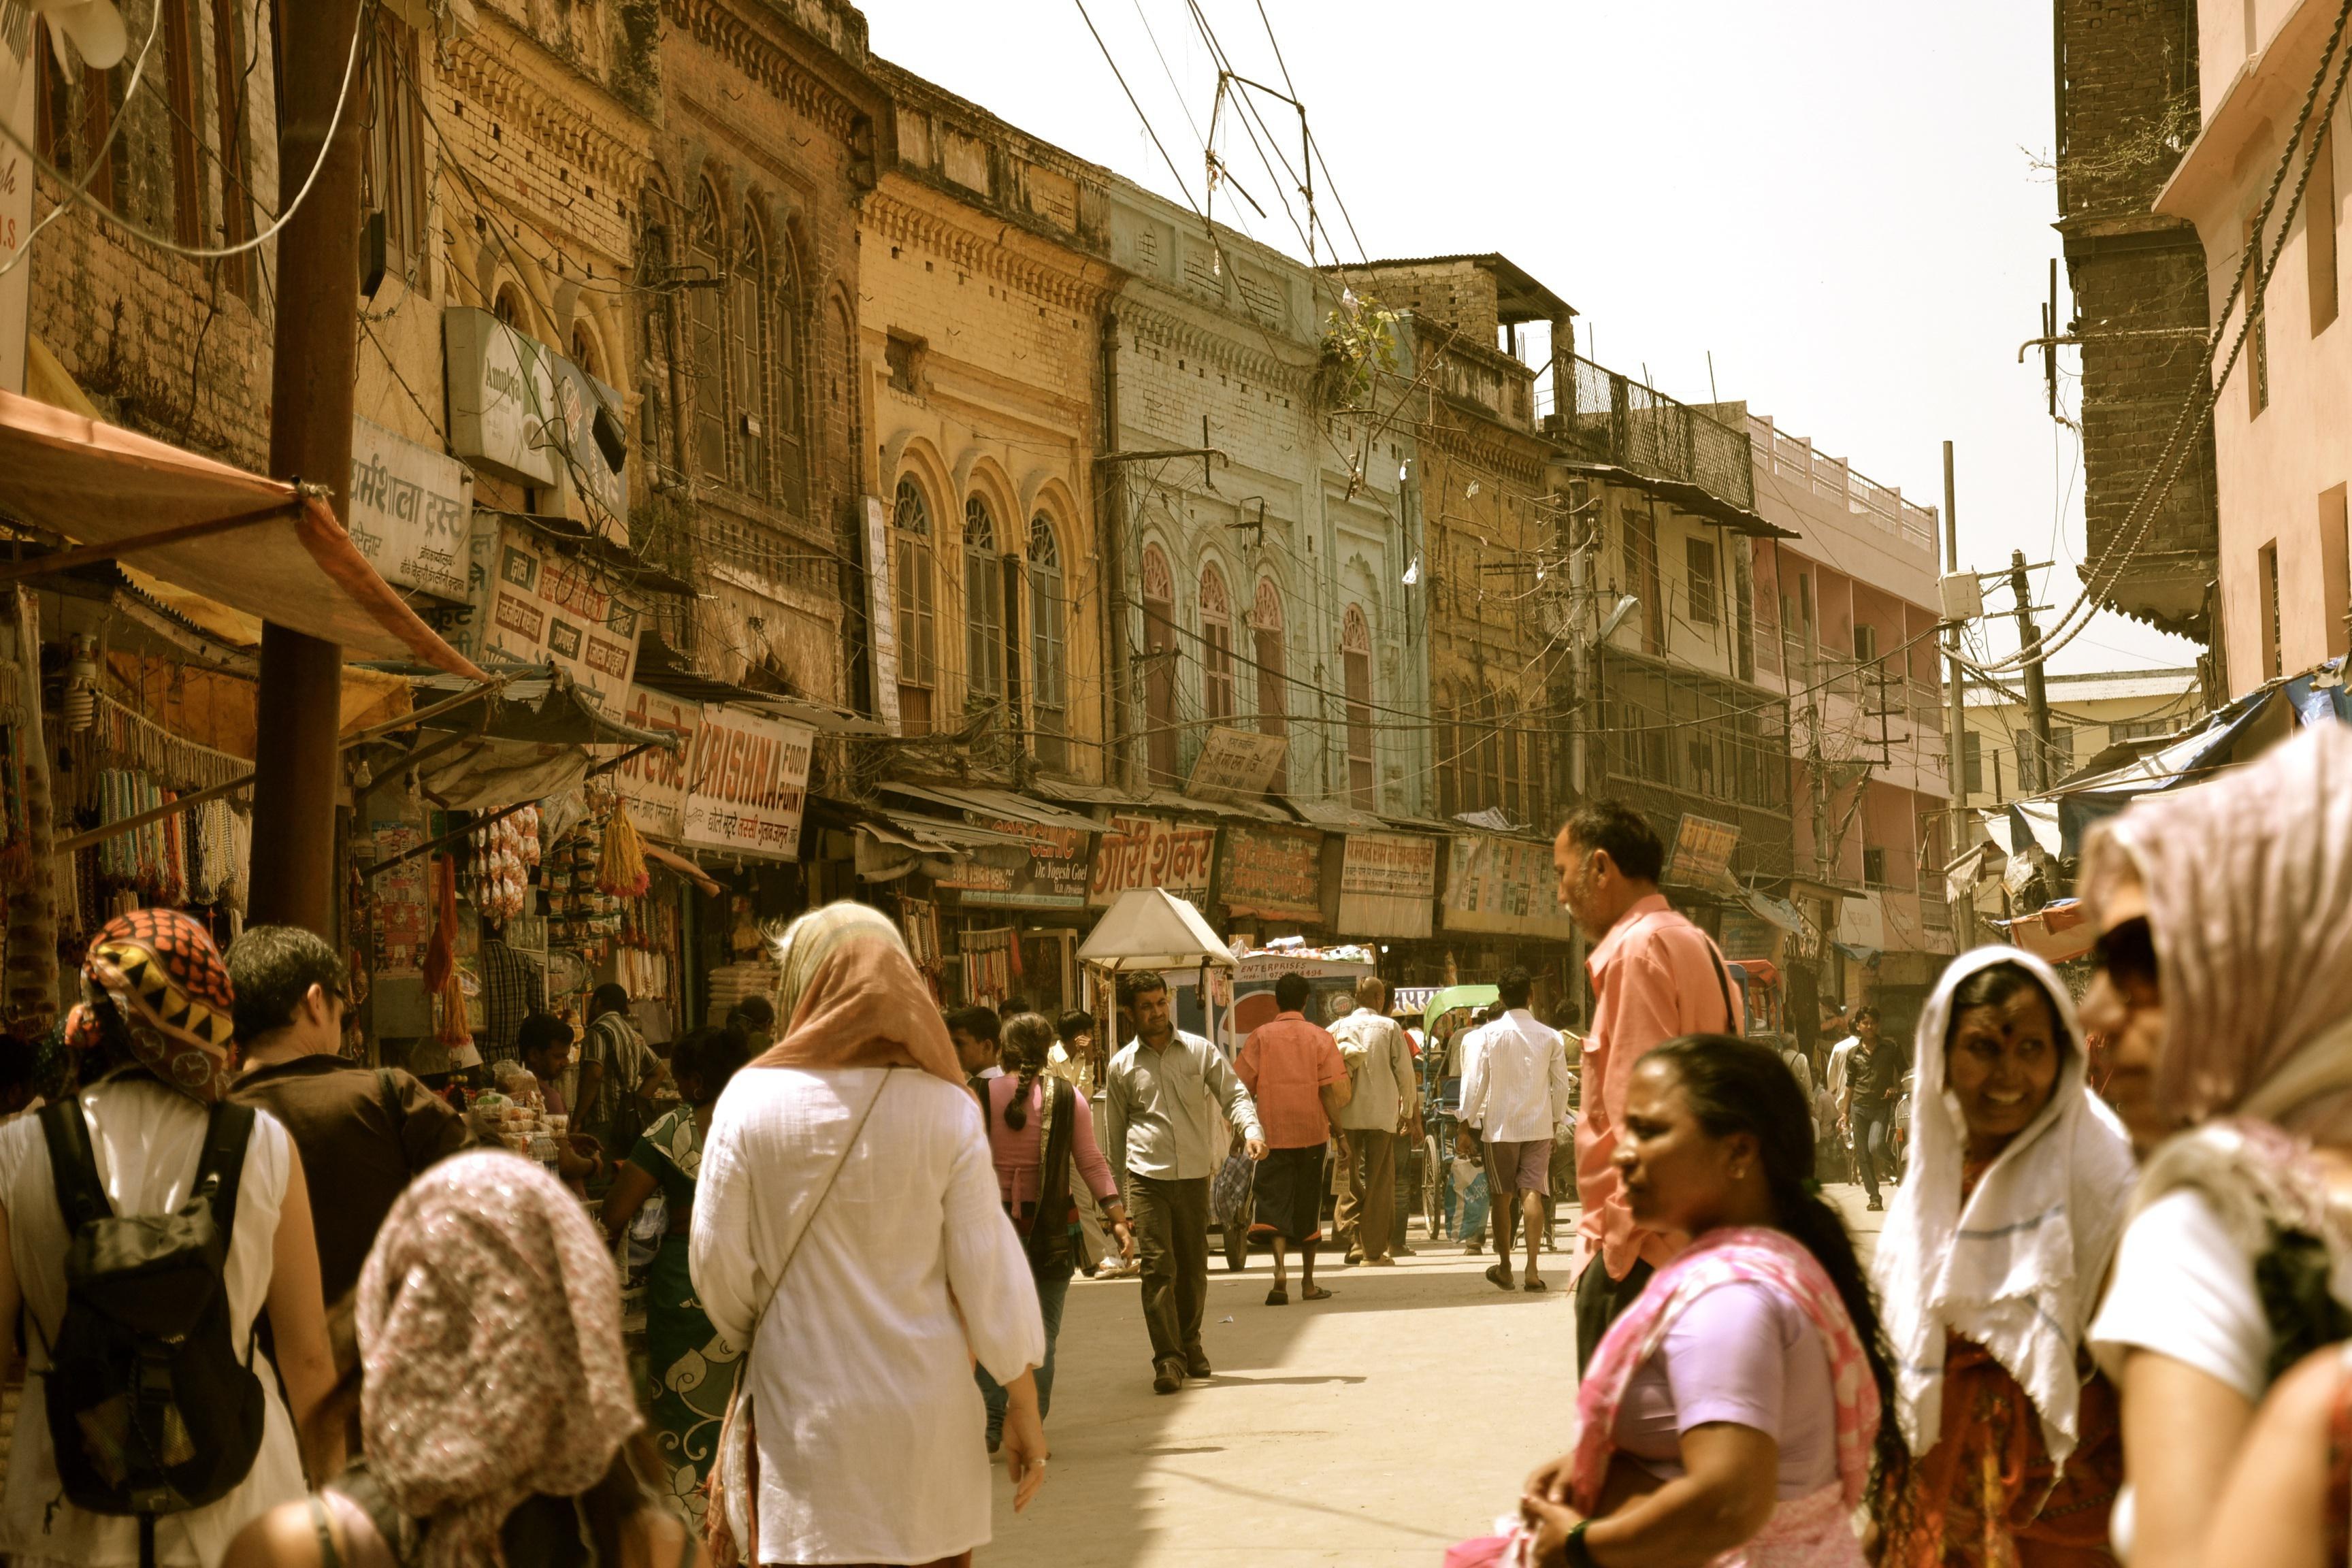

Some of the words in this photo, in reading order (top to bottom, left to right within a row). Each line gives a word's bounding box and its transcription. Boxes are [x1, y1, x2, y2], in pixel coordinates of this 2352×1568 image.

[485, 357, 522, 405] Amulya
[425, 489, 464, 538] ट्रस्ट
[693, 721, 782, 811] KRISHNA
[782, 742, 808, 776] FOOD
[777, 781, 804, 814] POINT
[1030, 822, 1077, 860] CLINIC
[1034, 861, 1046, 879] Dr.
[1047, 861, 1071, 884] Yogesh
[1071, 862, 1088, 881] Goel
[1241, 962, 1307, 973] ENTERPRISES
[1269, 968, 1324, 979] 9754494
